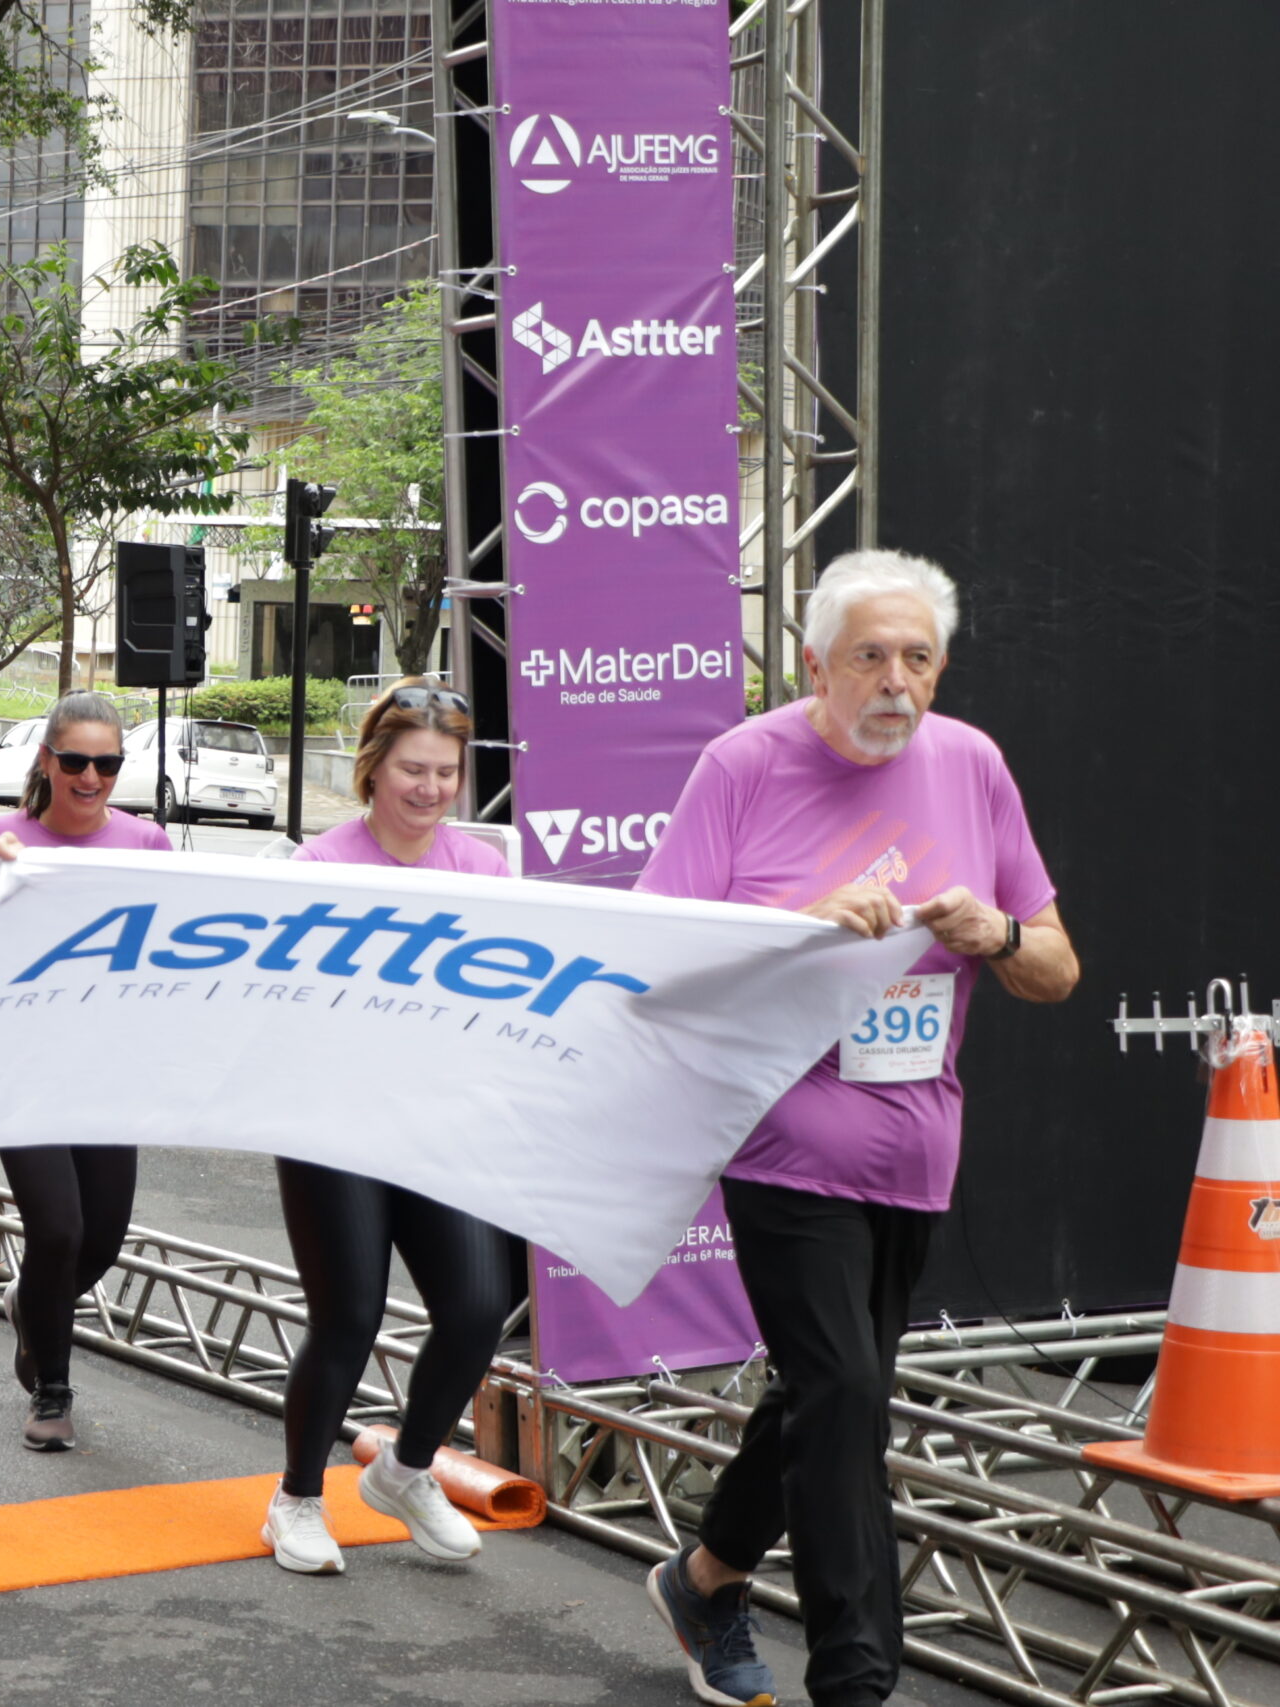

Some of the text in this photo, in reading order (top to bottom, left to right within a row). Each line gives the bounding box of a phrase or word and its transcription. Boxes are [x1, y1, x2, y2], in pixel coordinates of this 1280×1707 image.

[587, 134, 718, 173] AJUFEMG
[577, 319, 721, 357] Asttter
[580, 494, 728, 537] copasa
[559, 641, 732, 685] MaterDei
[560, 687, 661, 704] Rede de Saúde
[7, 902, 651, 1019] Asttter
[883, 983, 921, 999] RF6
[118, 982, 191, 999] TRF
[242, 983, 315, 1002] TRE
[364, 995, 450, 1021] MPT
[496, 1022, 584, 1063] MPF
[850, 1003, 940, 1044] 396
[663, 1252, 680, 1265] ral
[683, 1251, 697, 1262] da
[700, 1249, 712, 1261] 6ª
[714, 1248, 736, 1261] Reg
